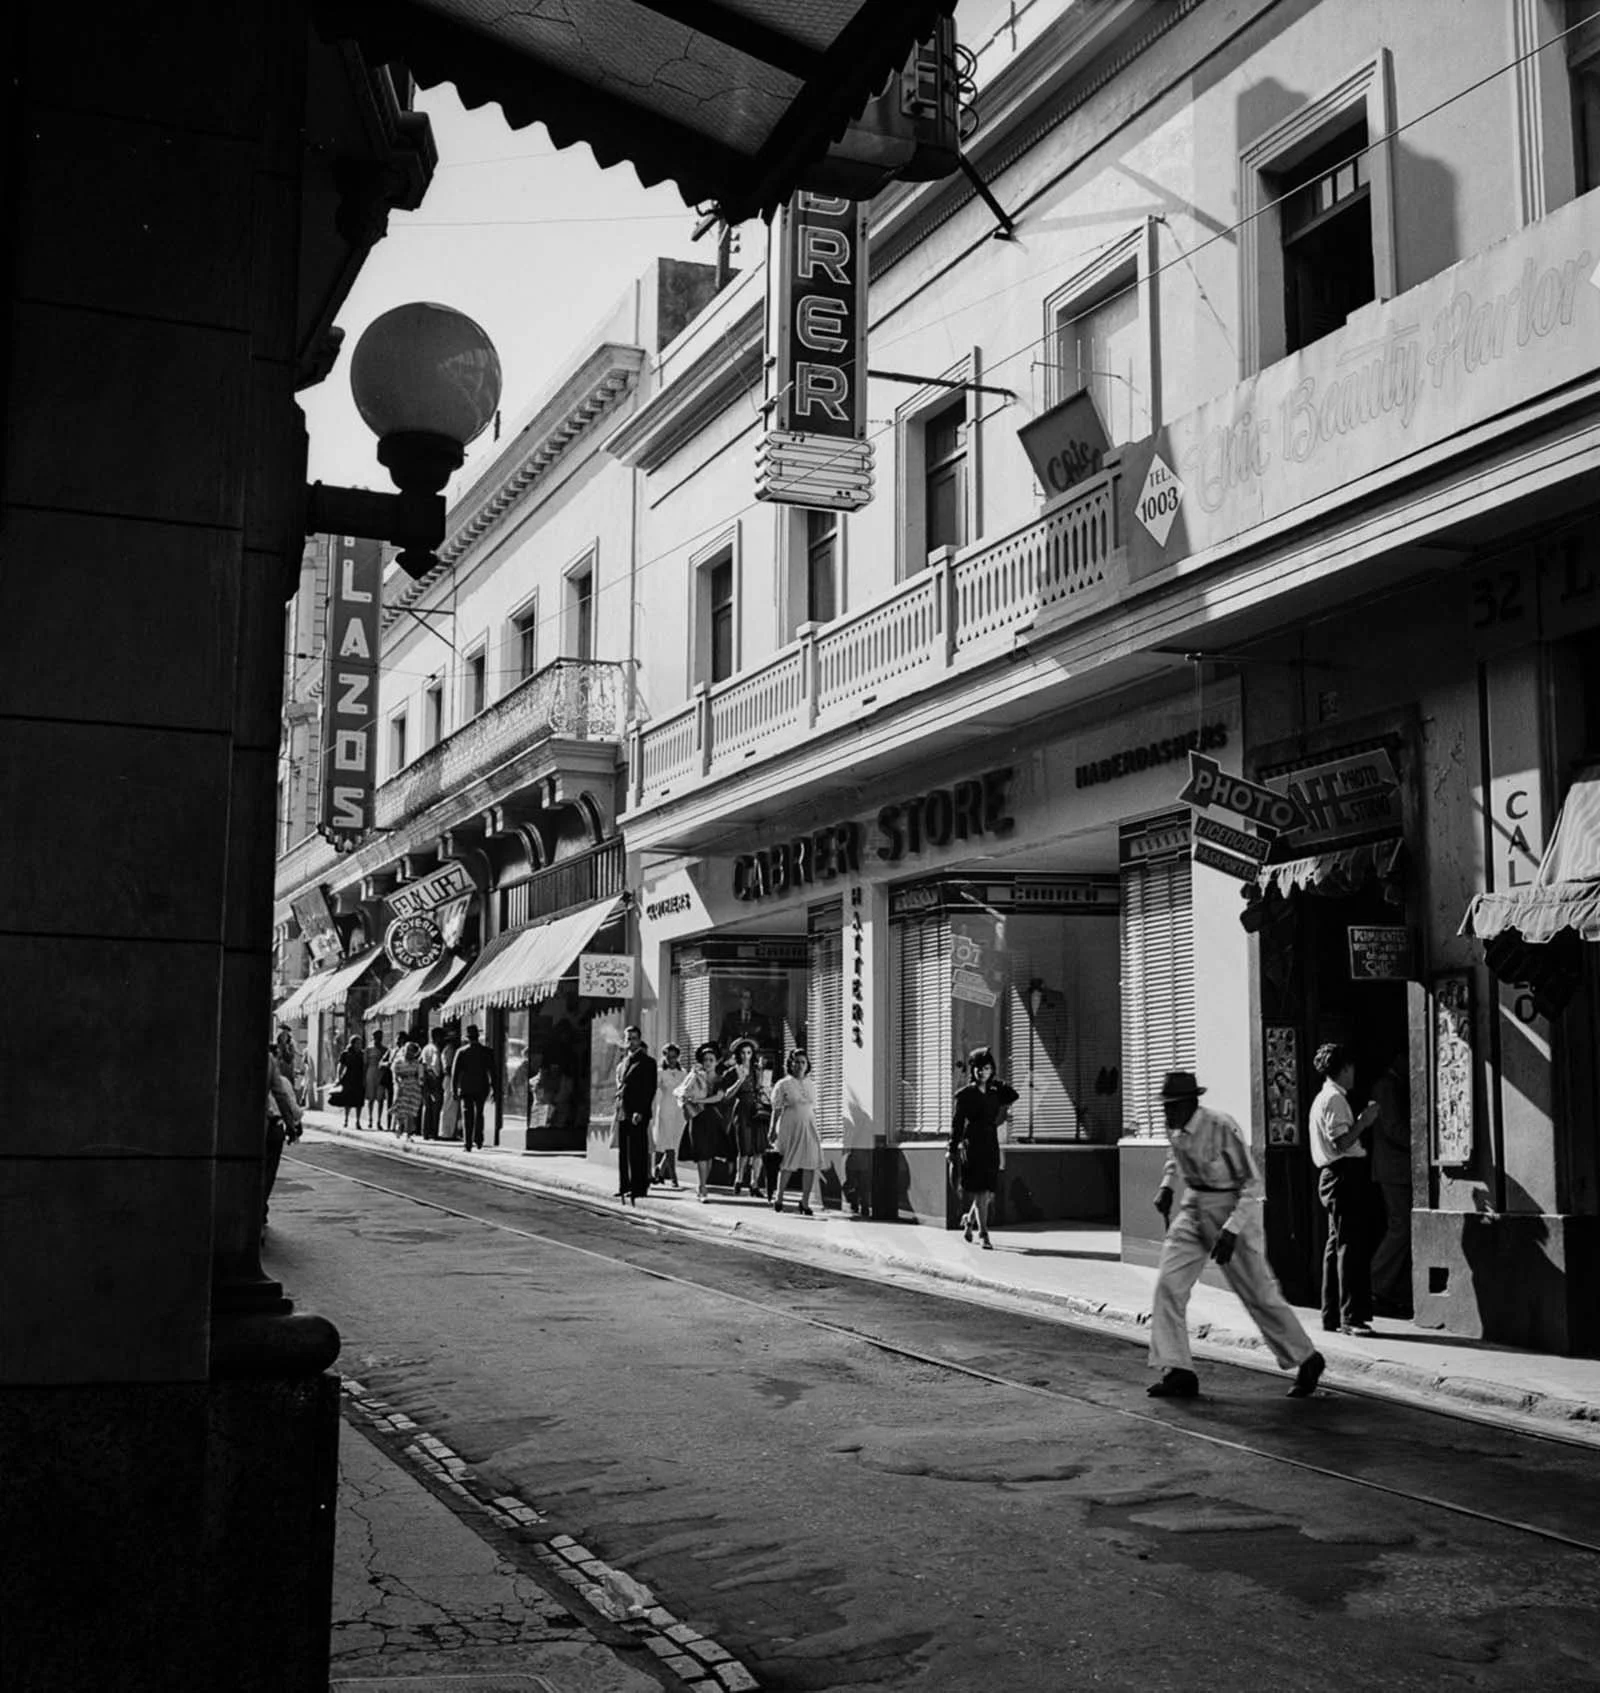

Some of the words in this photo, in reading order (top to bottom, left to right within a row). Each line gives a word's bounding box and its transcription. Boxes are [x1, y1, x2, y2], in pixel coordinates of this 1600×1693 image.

[1280, 325, 1424, 463] Beauty
[1427, 250, 1592, 388] Parlor
[1141, 486, 1178, 524] 1003
[1149, 467, 1172, 488] TEL.
[332, 536, 373, 829] LAZOS
[733, 820, 861, 903] CABRER
[877, 766, 1016, 862] STORE
[1194, 768, 1295, 828] PHOTO
[851, 886, 864, 1050] HATTERS
